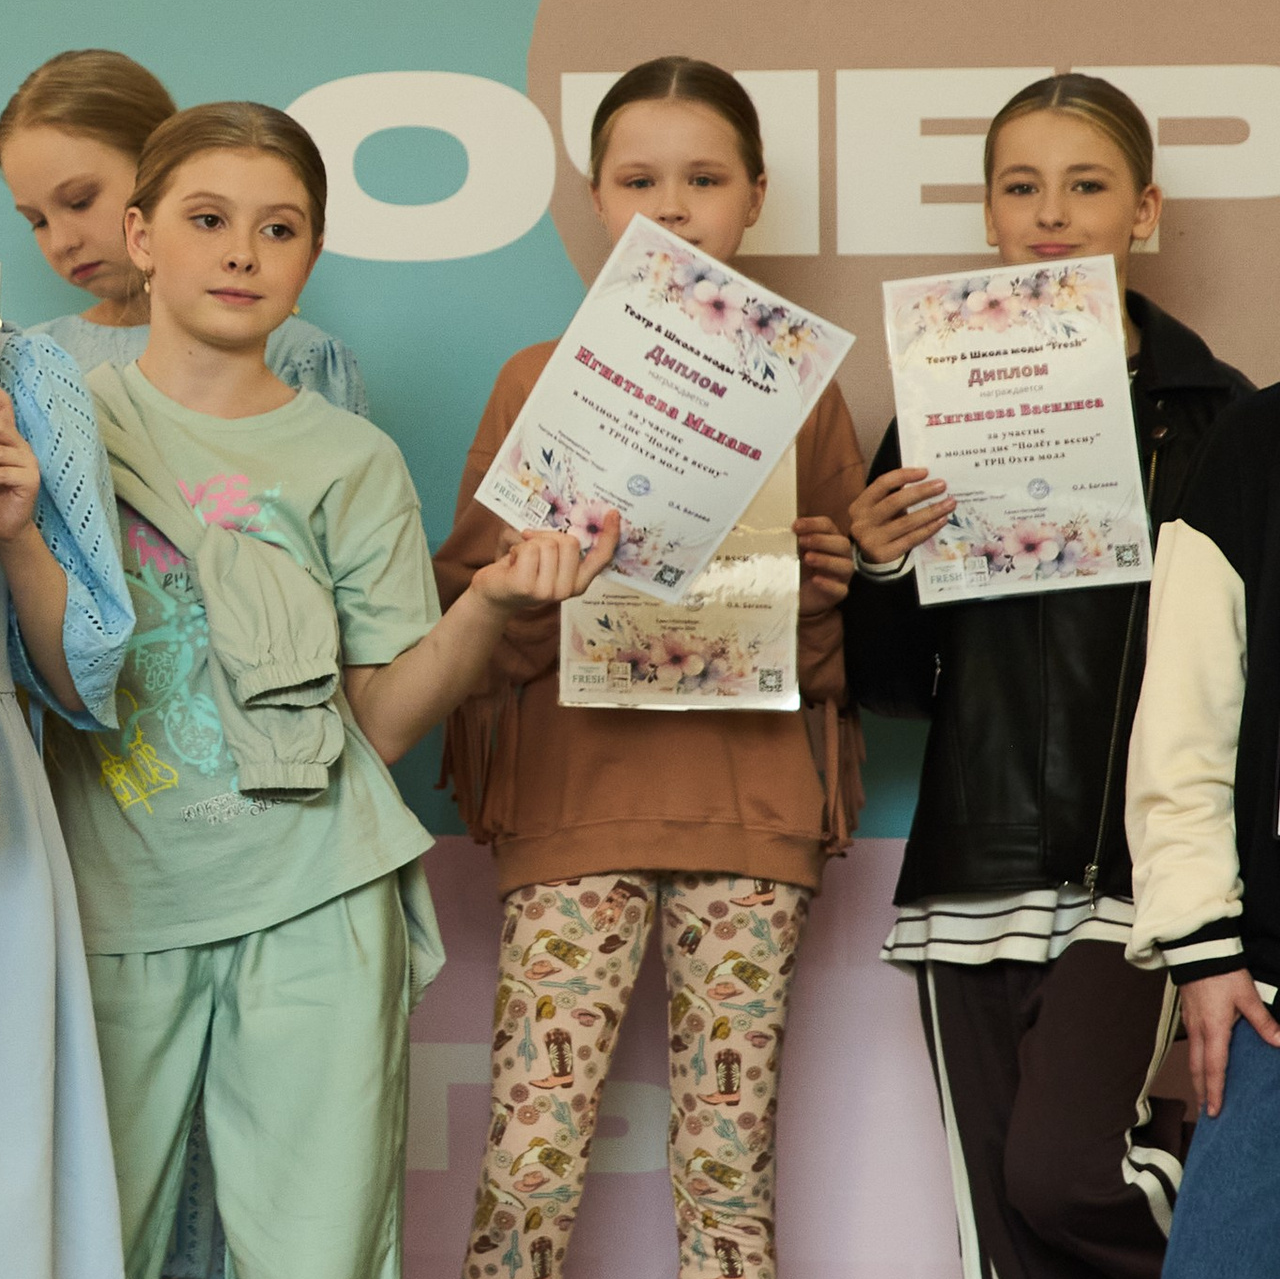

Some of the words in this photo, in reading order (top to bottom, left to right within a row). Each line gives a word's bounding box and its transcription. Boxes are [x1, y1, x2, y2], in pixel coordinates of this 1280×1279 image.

[624, 303, 653, 329] Театр
[664, 329, 701, 357] Школа
[702, 351, 735, 376] моды
[925, 355, 958, 366] Театр
[970, 348, 1009, 360] Школа
[1011, 344, 1044, 355] моды
[645, 344, 728, 399] Диплом
[968, 363, 1050, 388] Диплом
[575, 345, 680, 420] Игнатьева
[683, 411, 763, 462] Милана
[925, 406, 1016, 427] Жиганова
[1019, 397, 1105, 416] Василиса
[627, 409, 639, 419] за
[641, 415, 684, 444] участие
[631, 441, 657, 461] Охта
[493, 481, 524, 509] FRESH
[930, 571, 963, 584] FRESH
[572, 675, 605, 684] FRESH
